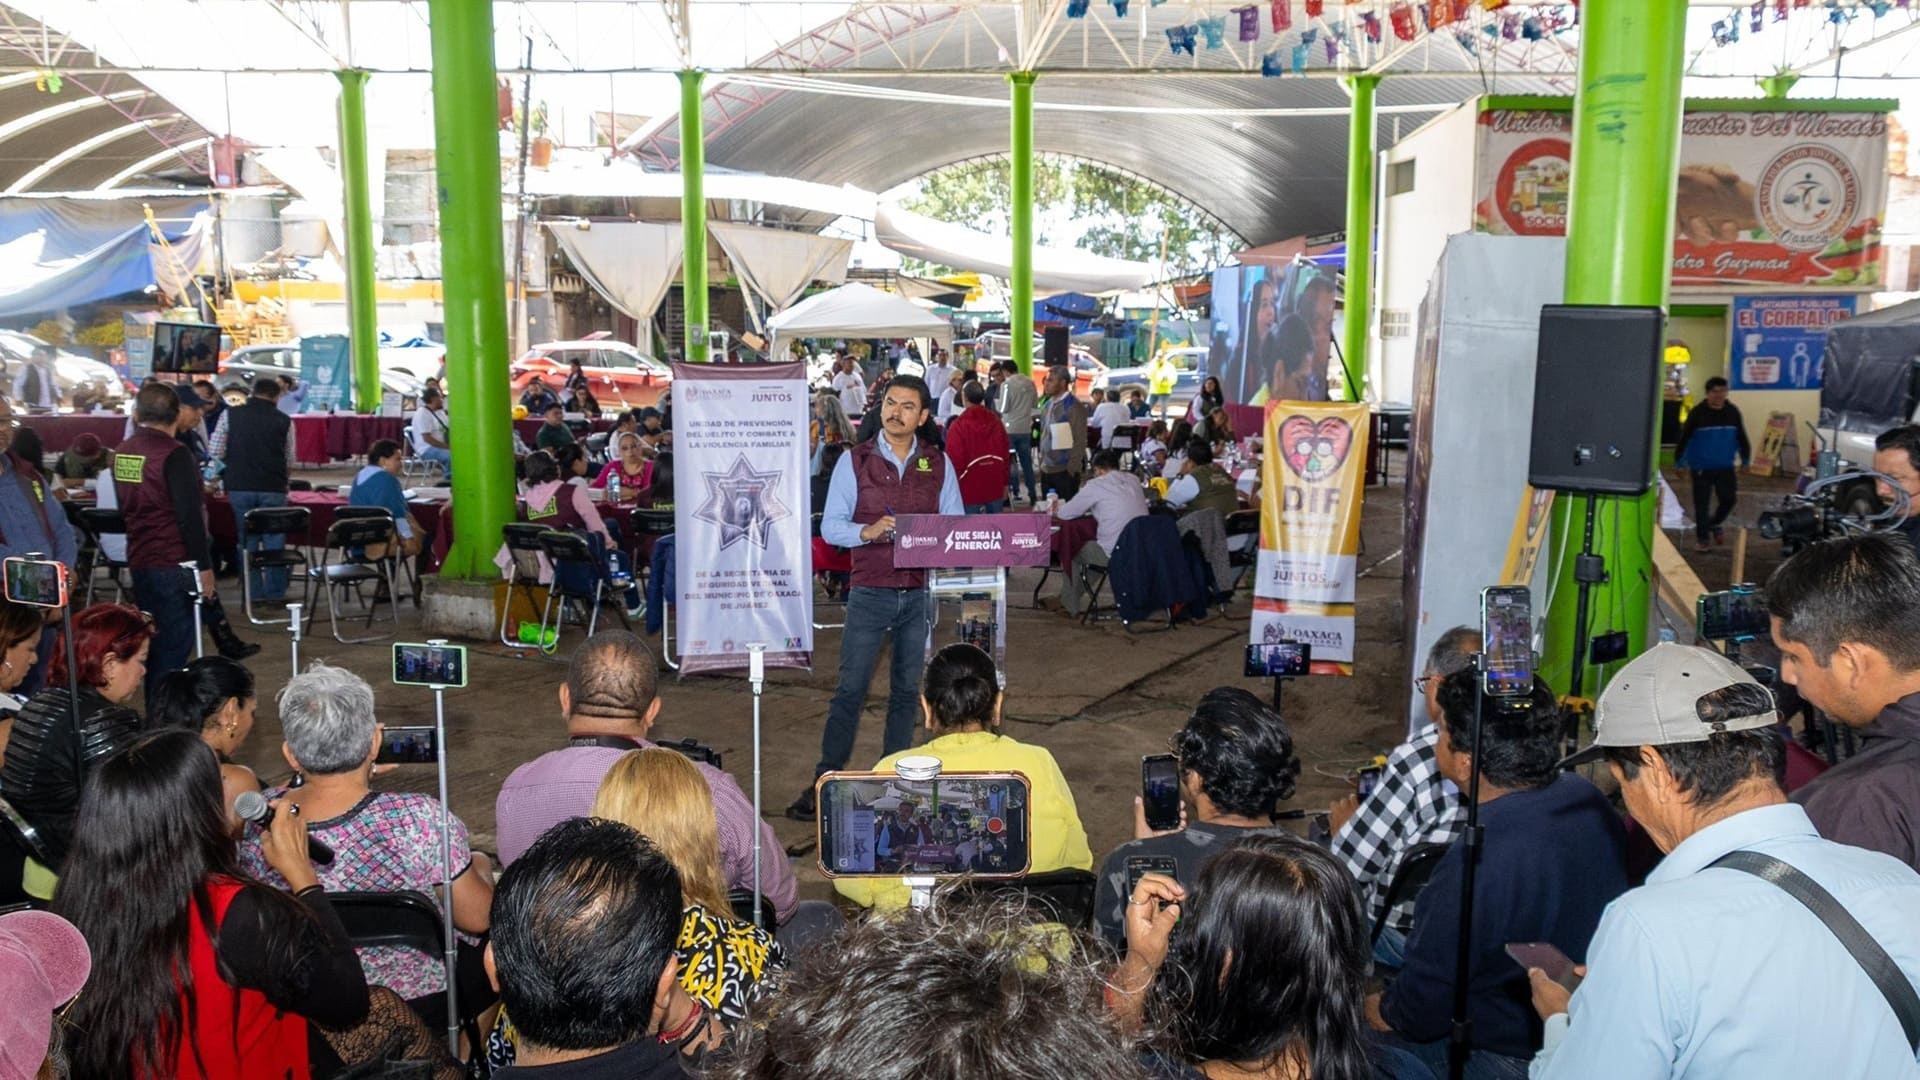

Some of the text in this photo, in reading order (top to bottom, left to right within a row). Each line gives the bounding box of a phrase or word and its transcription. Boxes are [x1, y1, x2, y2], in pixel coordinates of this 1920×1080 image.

[1493, 110, 1562, 133] Unidos
[1683, 113, 1746, 136] nestar
[1738, 308, 1759, 328] EL
[751, 393, 792, 402] JUNTOS
[689, 418, 793, 428] UNDAD DE PREVENCIÓN
[703, 441, 749, 449] VIOLENCIA
[751, 441, 791, 449] FAMILIAR
[1283, 485, 1341, 514] DIF
[955, 531, 1002, 540] QUE SIGA LA
[1011, 536, 1037, 545] JUNTOS
[955, 540, 1001, 550] ENERGÍA
[724, 569, 779, 577] SECRTARIA
[1273, 570, 1326, 583] JUNTOS
[1293, 629, 1342, 641] OAXACA
